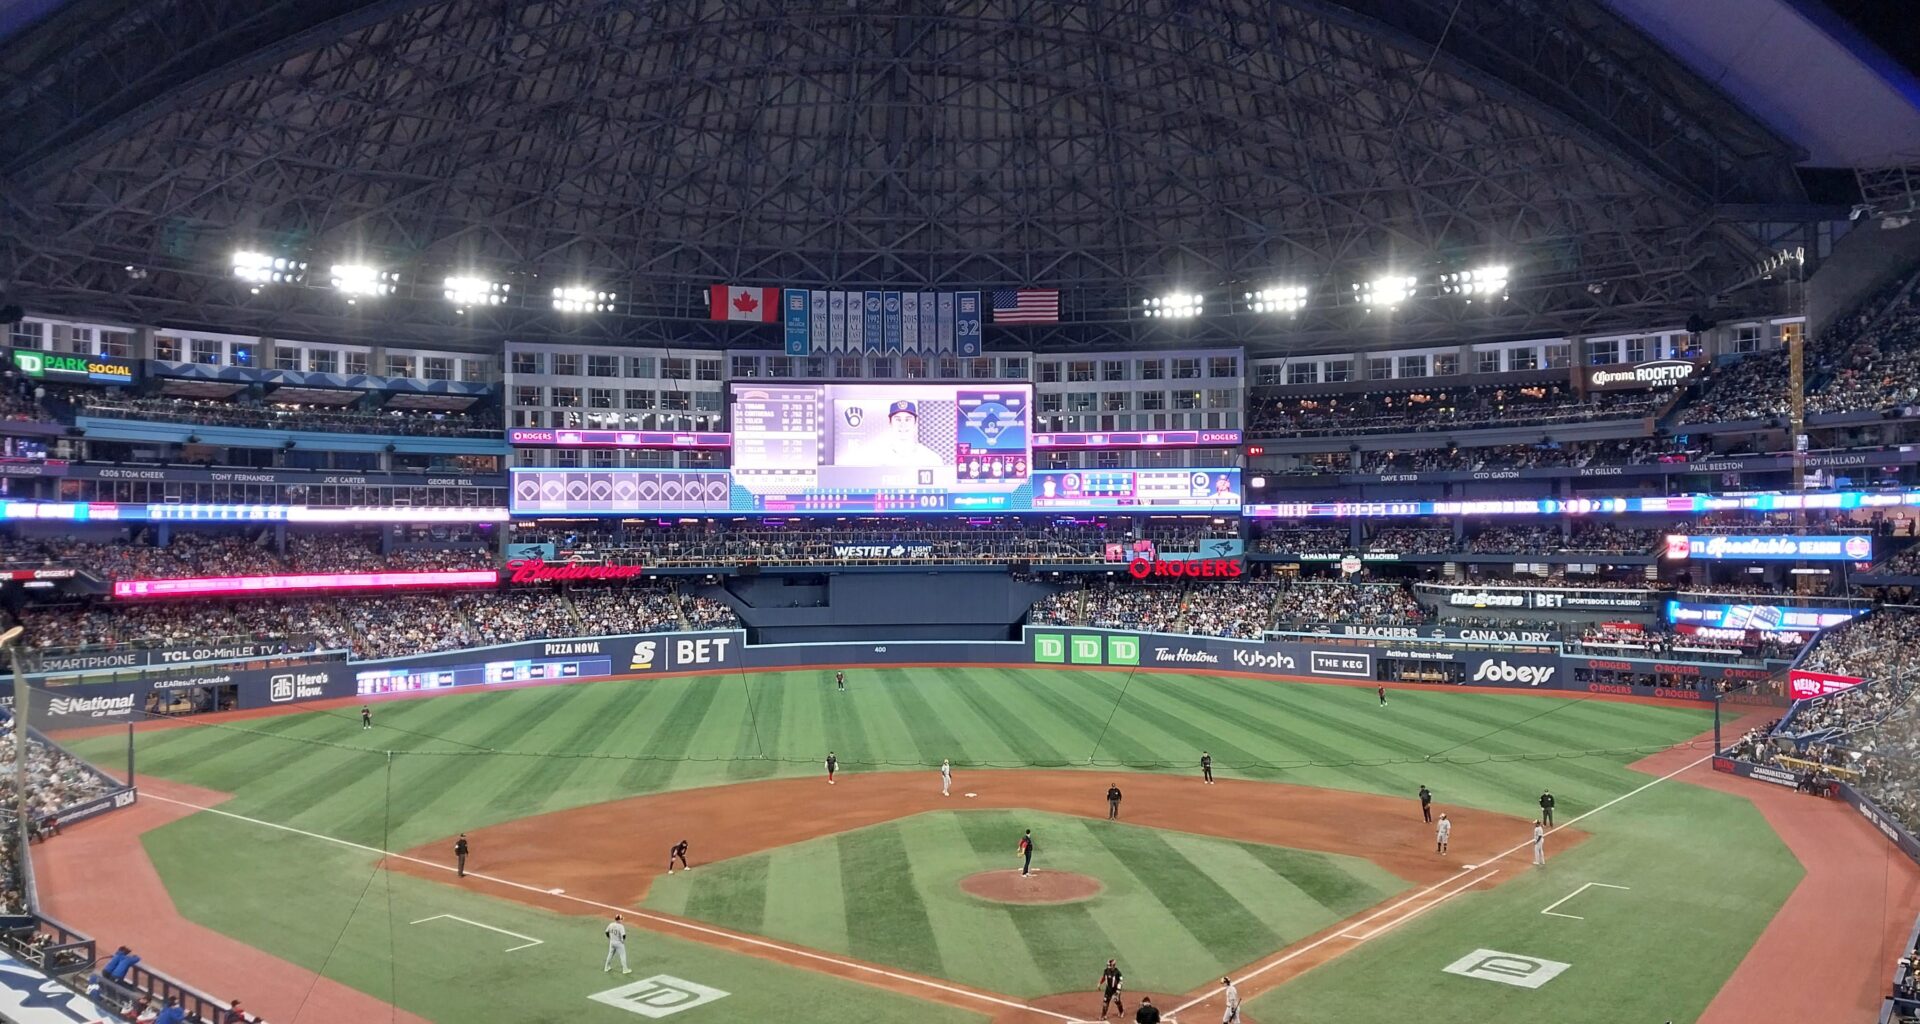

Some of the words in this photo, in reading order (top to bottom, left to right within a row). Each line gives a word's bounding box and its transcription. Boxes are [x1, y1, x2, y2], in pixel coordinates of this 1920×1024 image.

[958, 319, 979, 336] 32
[16, 355, 41, 371] TD
[44, 356, 87, 371] PARK
[88, 363, 131, 375] SOCIAL
[1592, 371, 1635, 385] Corona
[1636, 364, 1692, 381] ROOFTOP
[522, 433, 552, 441] ROGERS
[1211, 433, 1238, 441] ROGERS
[1690, 463, 1707, 472] PAUL
[1709, 461, 1743, 471] BEESTON
[1806, 458, 1821, 466] ROY
[1823, 455, 1866, 465] HALLADAY
[6, 465, 42, 474] DELGADO
[100, 469, 119, 478] 4306
[121, 469, 139, 478] TOM
[140, 470, 164, 479] CHEEK
[1491, 471, 1519, 479] GASTON
[1581, 468, 1596, 476] PAT
[1597, 467, 1622, 475] GILLICK
[211, 473, 231, 482] TONY
[234, 473, 275, 483] FERNANDEZ
[427, 478, 455, 486] GEORGE
[920, 471, 931, 483] 10
[834, 546, 890, 557] WESTJET
[506, 558, 642, 583] Budweiser
[1155, 560, 1242, 577] ROGERS
[1450, 592, 1523, 607] theScore
[1536, 594, 1564, 608] BET
[1567, 598, 1609, 606] SPORTSBOOK
[1616, 599, 1640, 607] CASINO
[1345, 625, 1418, 638] BLEACHERS
[1521, 631, 1550, 642] DRY
[162, 650, 191, 662] TCL
[260, 645, 274, 655] TV
[545, 642, 573, 655] PIZZA
[574, 641, 598, 654] NOVA
[677, 638, 730, 664] BET
[1038, 639, 1062, 657] TD
[1074, 640, 1098, 658] TD
[1111, 641, 1136, 659] TD
[1386, 650, 1408, 658] Active
[1155, 647, 1178, 662] Tim
[1179, 647, 1218, 663] Hortons
[1233, 649, 1295, 669] Kubota
[42, 654, 136, 672] SMARTPHONE
[1317, 658, 1338, 668] THE
[1342, 659, 1363, 669] KEG
[1598, 660, 1632, 671] ROGERS
[1473, 658, 1555, 685] Sobeys
[1663, 664, 1699, 675] ROGERS
[1733, 668, 1772, 679] ROGERS
[198, 676, 224, 685] Canada
[297, 671, 328, 686] Here's
[297, 685, 322, 698] How.
[1598, 683, 1632, 694] ROGERS
[1793, 678, 1821, 694] HEINZ
[1663, 688, 1700, 699] ROGERS
[68, 693, 134, 713] National
[106, 708, 131, 716] Rental
[1753, 766, 1776, 777] CANADIAN
[623, 980, 700, 1008] TD
